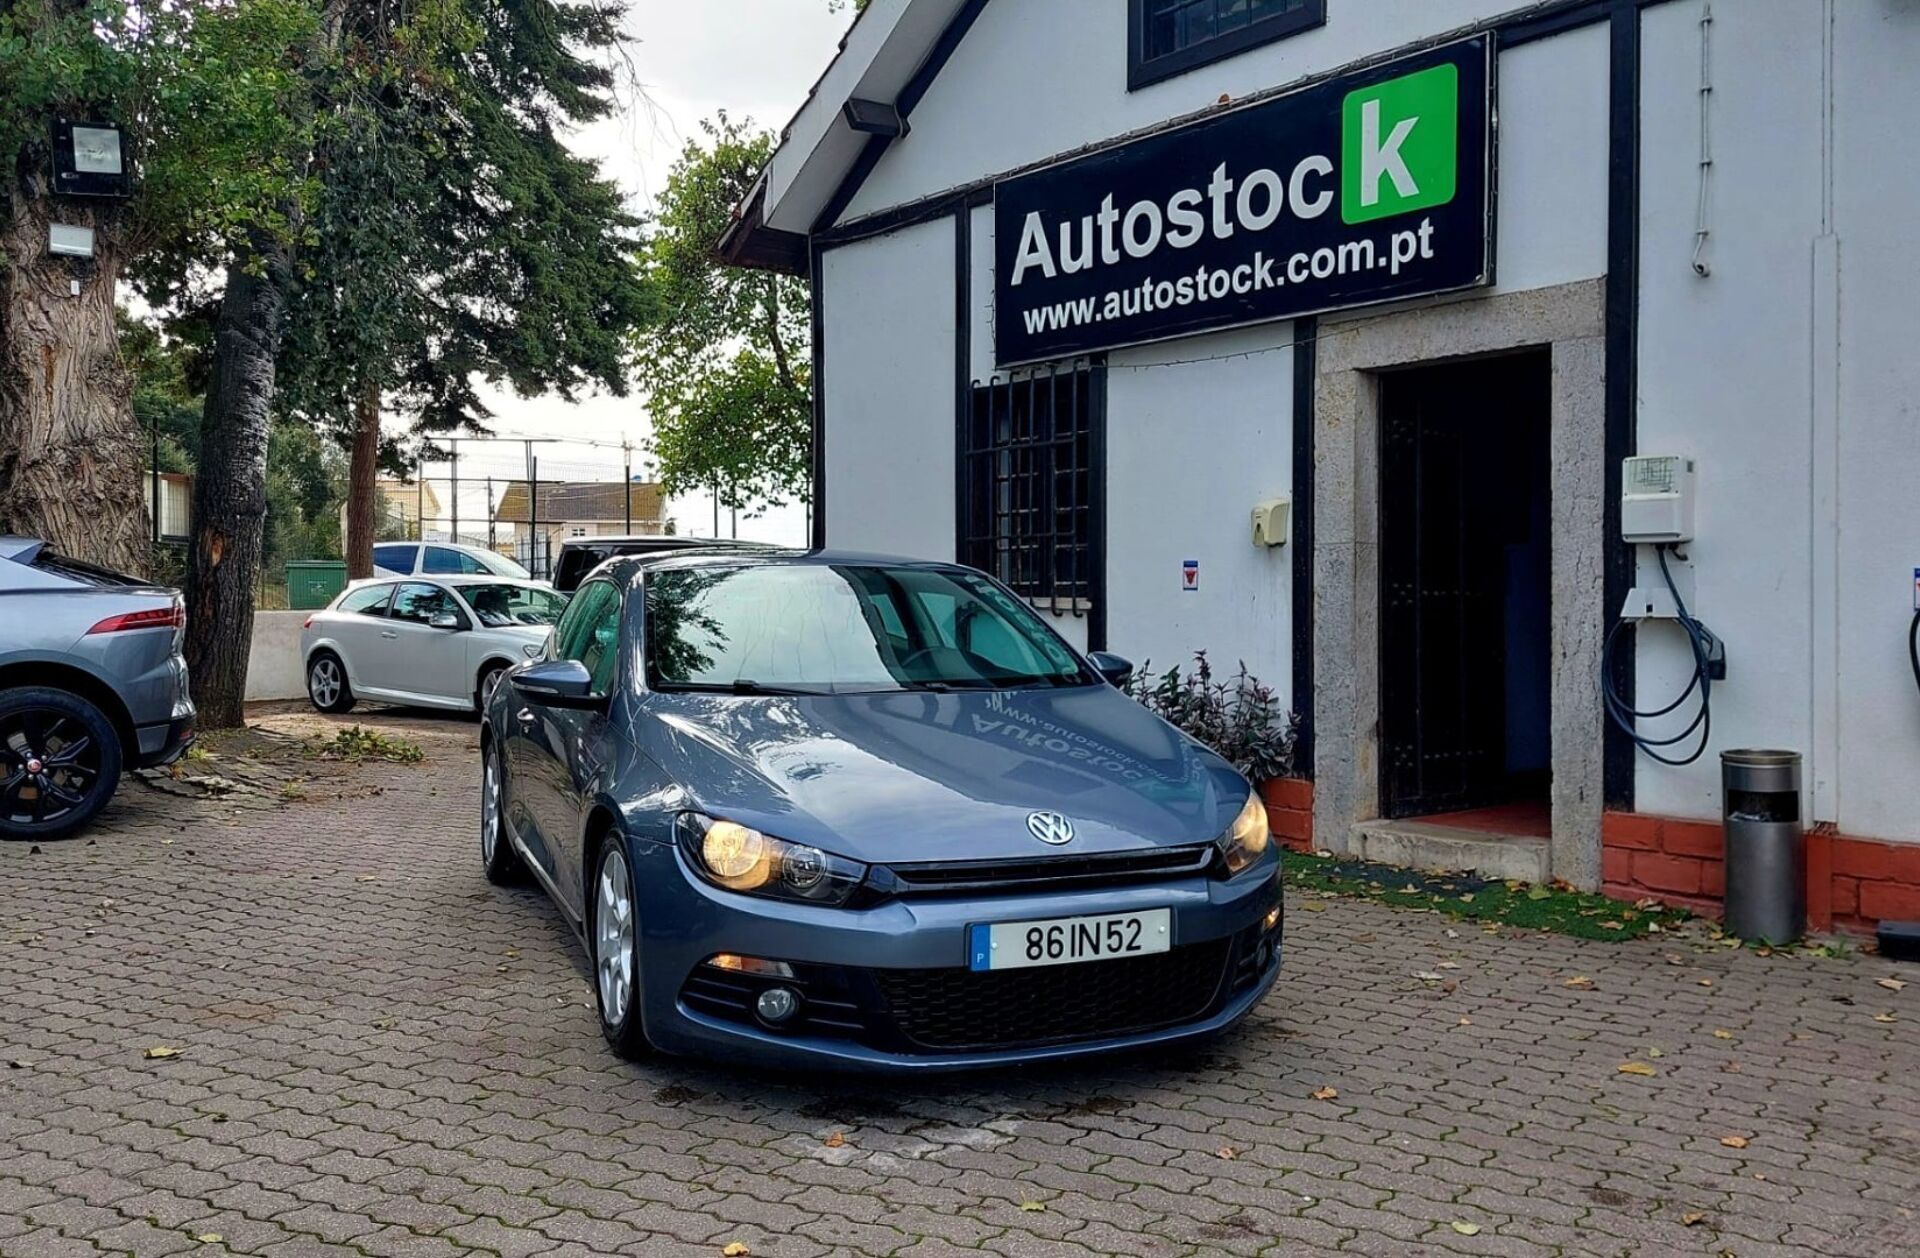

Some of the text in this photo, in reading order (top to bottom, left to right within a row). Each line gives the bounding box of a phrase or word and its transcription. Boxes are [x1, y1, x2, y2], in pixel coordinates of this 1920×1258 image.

[1010, 98, 1420, 286] Autostock
[1023, 217, 1435, 335] www.autostock.com.pt
[976, 952, 985, 964] P
